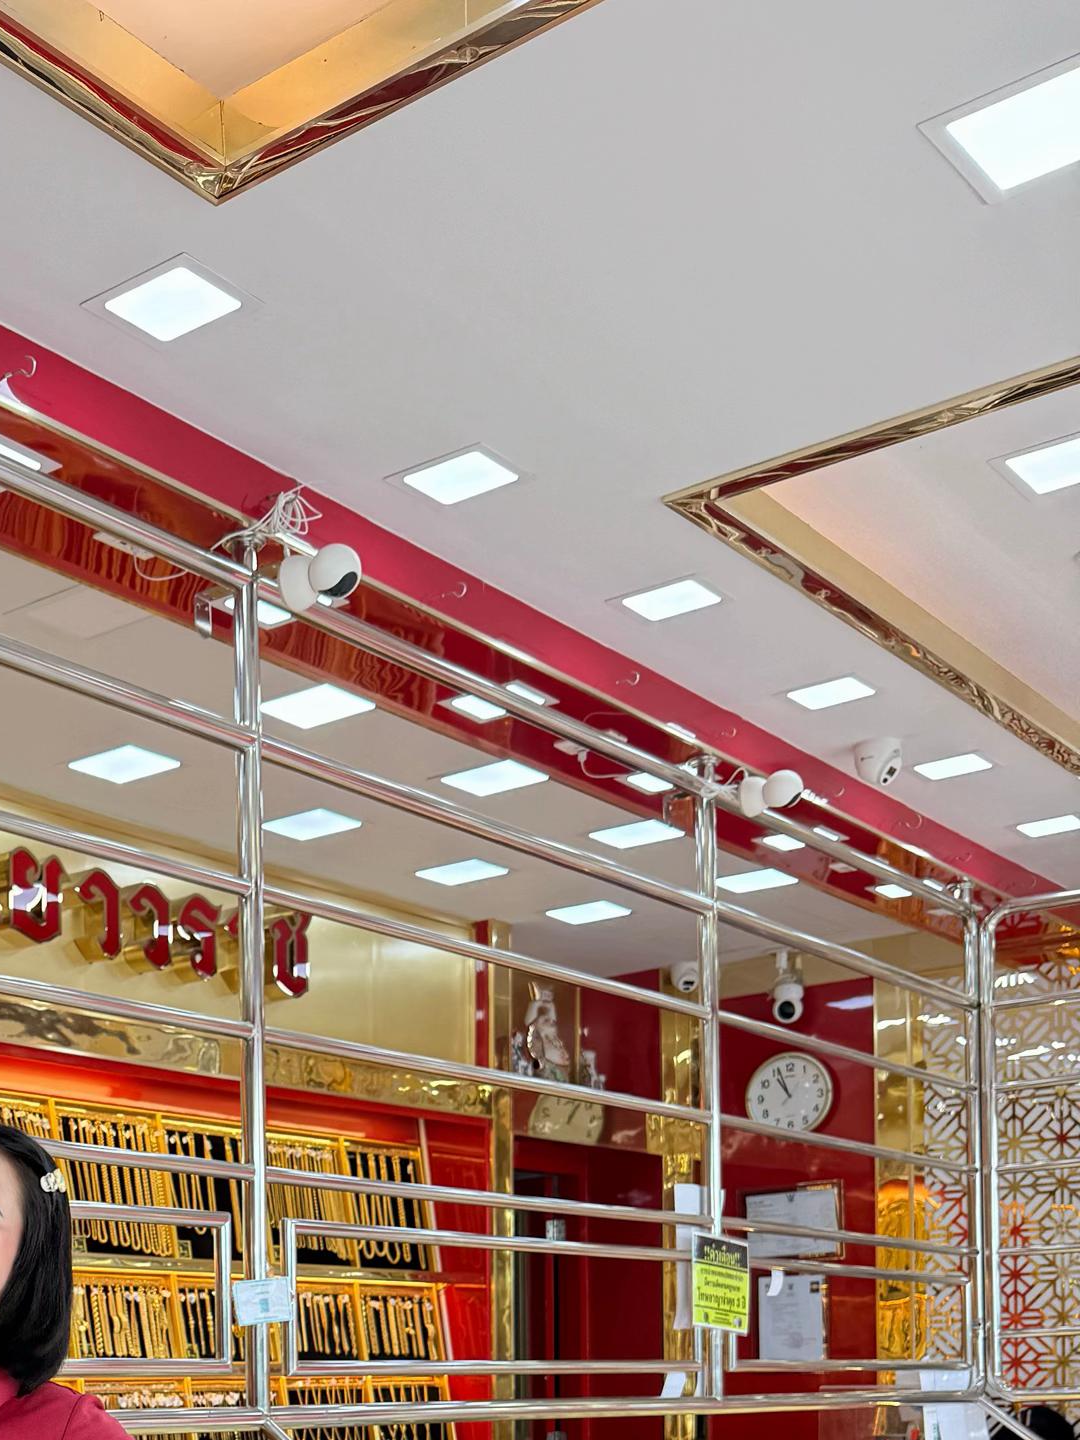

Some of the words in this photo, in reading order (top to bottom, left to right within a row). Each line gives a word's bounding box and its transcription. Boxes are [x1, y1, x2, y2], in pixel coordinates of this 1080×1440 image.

[785, 1062, 795, 1072] 12
[802, 1065, 807, 1074] 1
[812, 1073, 820, 1084] 2
[761, 1079, 770, 1089] 10
[816, 1088, 824, 1098] 3
[757, 1094, 765, 1105] 9
[762, 1108, 769, 1119] 8
[812, 1104, 819, 1113] 4
[787, 1121, 794, 1129] 6
[802, 1115, 809, 1125] 5
